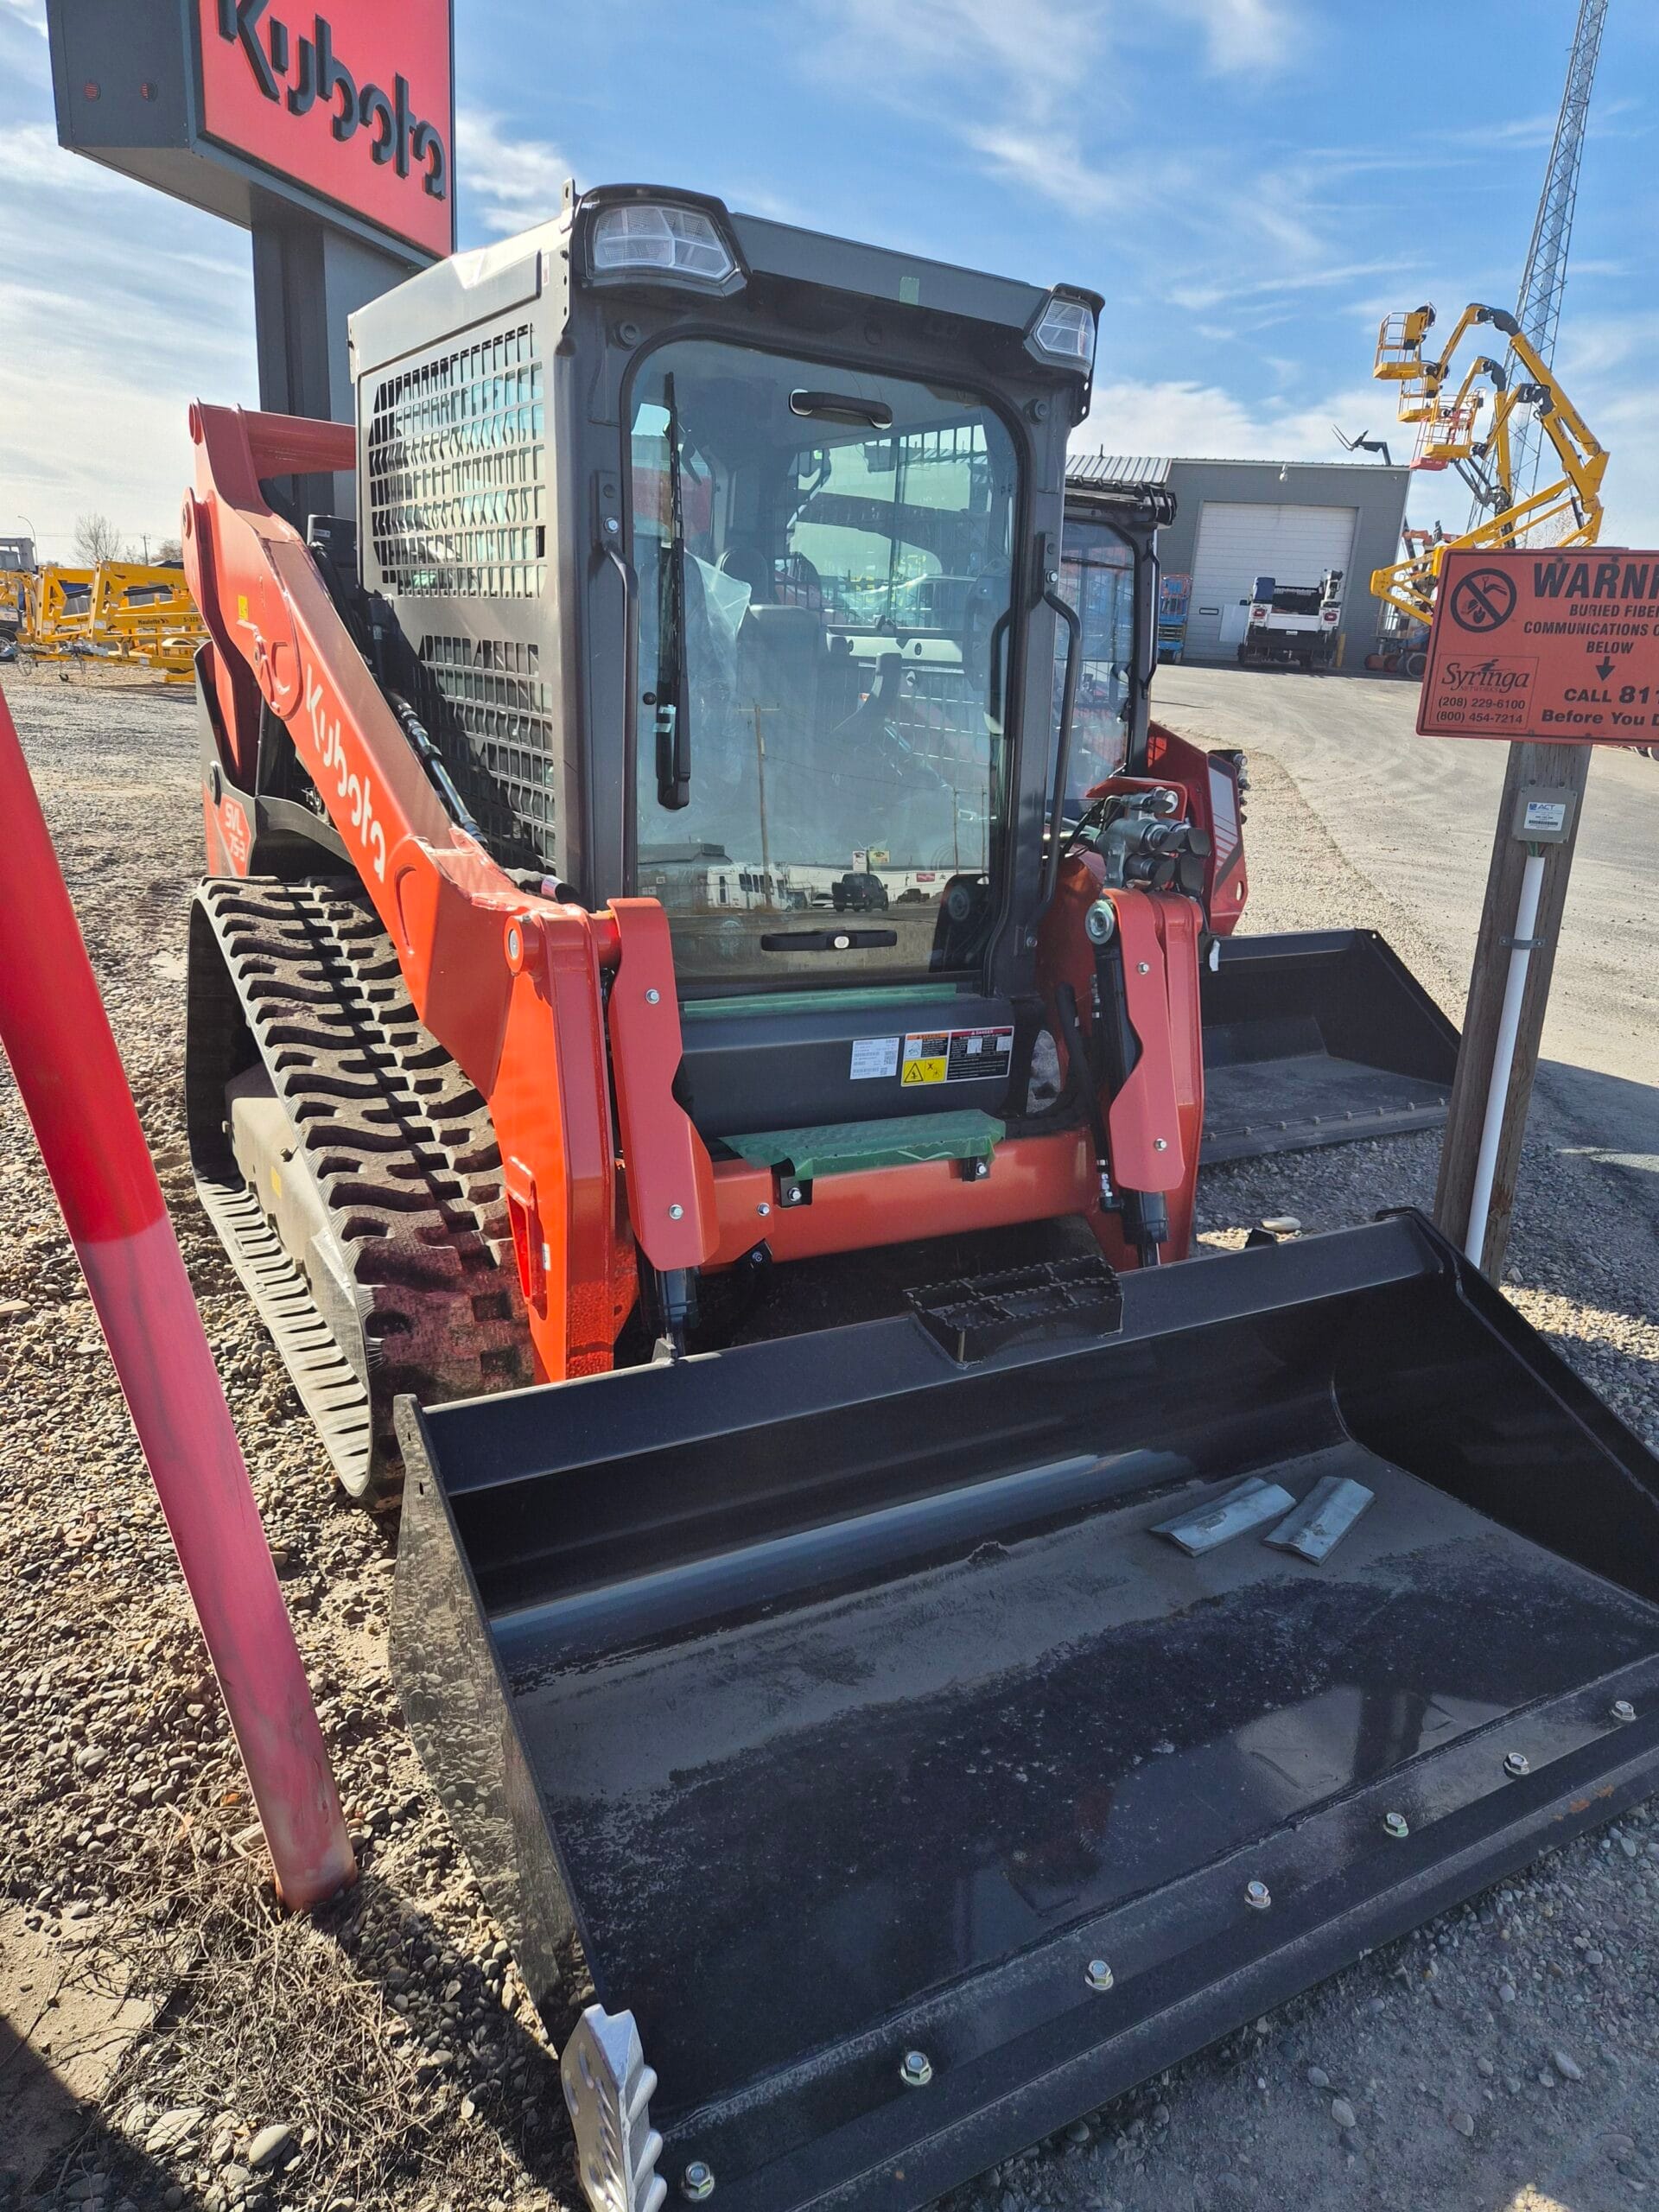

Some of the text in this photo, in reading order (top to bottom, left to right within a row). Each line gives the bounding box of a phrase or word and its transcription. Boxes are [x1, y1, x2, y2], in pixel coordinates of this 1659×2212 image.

[216, 0, 446, 201] Kubota
[1569, 604, 1619, 617] BURIED
[1523, 620, 1649, 636] COMMUNICATIONS
[1586, 641, 1634, 654] BELOW
[1441, 659, 1530, 693] Syringa
[1439, 696, 1526, 709] (208) 229-6100
[1564, 688, 1612, 702] CALL
[1436, 711, 1522, 724] (800) 454-7214
[1541, 709, 1604, 724] Before
[1611, 711, 1645, 726] You
[306, 664, 385, 883] Kubota
